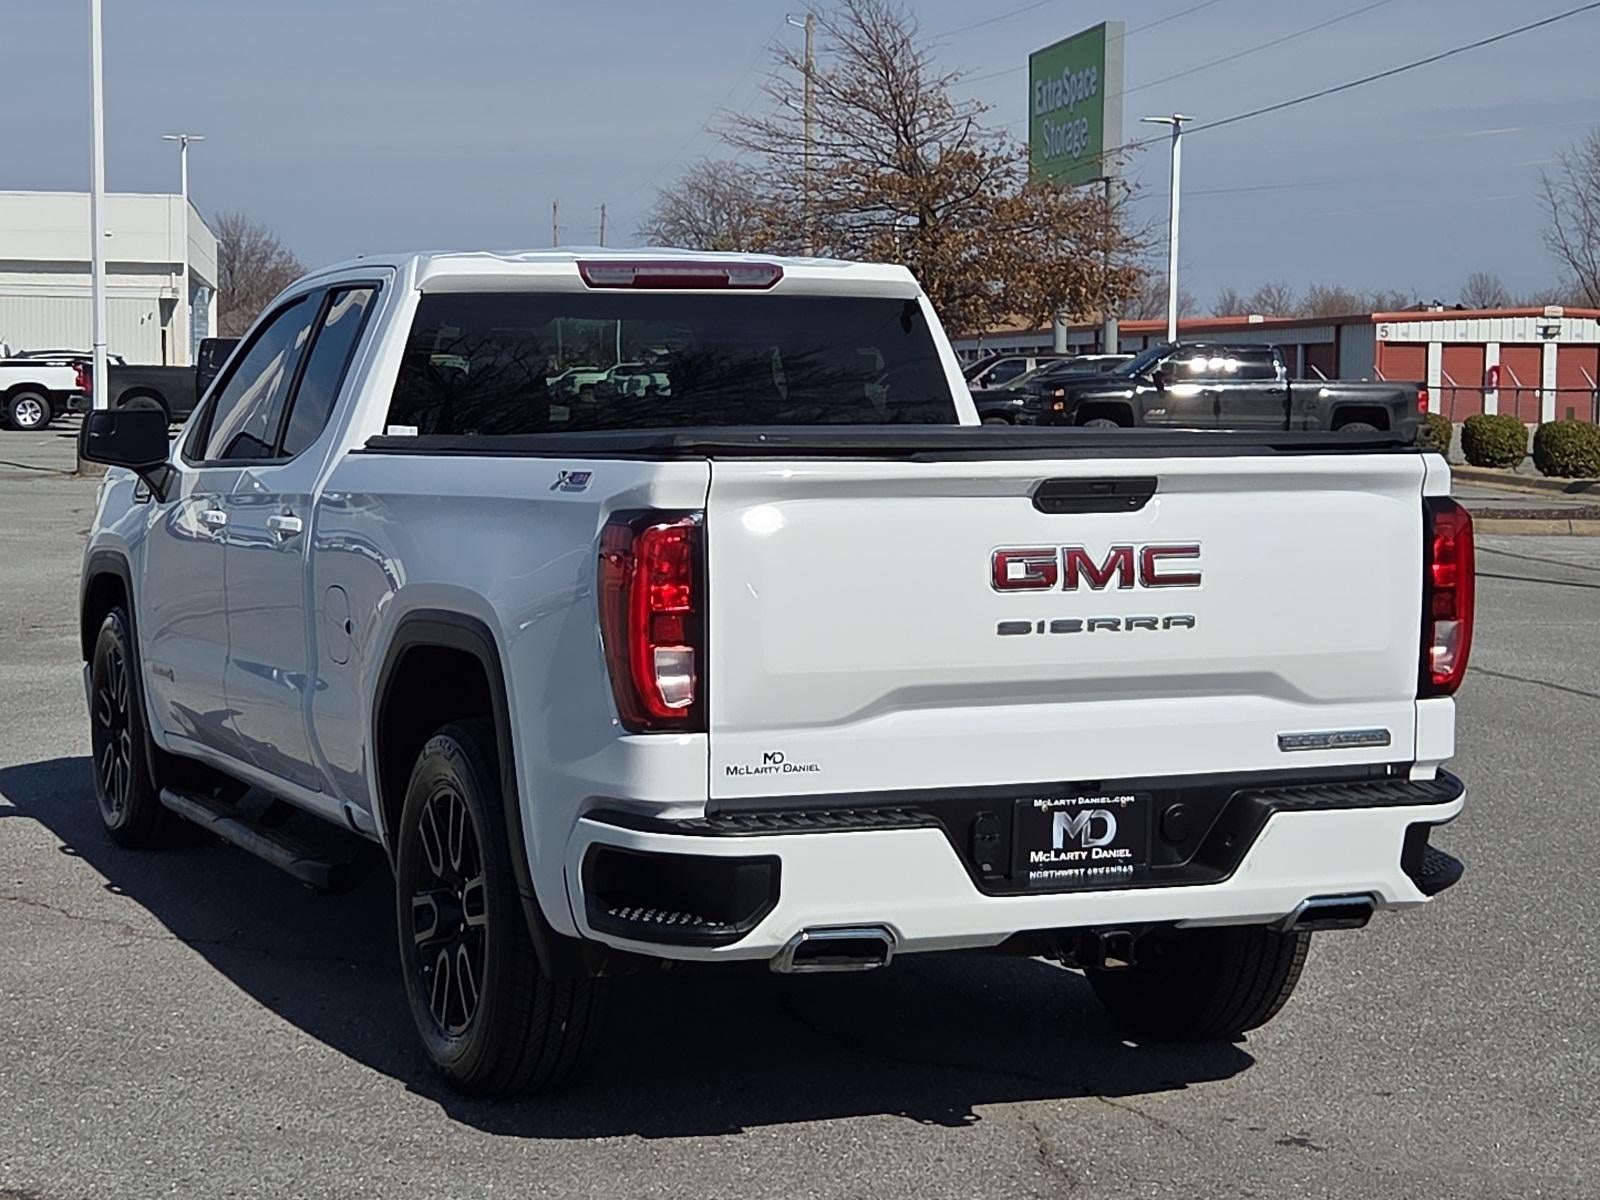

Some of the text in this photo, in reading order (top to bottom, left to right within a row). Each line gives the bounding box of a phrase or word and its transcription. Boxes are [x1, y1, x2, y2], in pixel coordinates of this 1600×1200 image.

[1034, 64, 1098, 115] ExtraSpace
[1043, 117, 1089, 159] Storage
[1380, 325, 1389, 338] 5
[991, 543, 1202, 592] GMC
[996, 614, 1196, 636] SIERRA
[1052, 809, 1117, 849] MD
